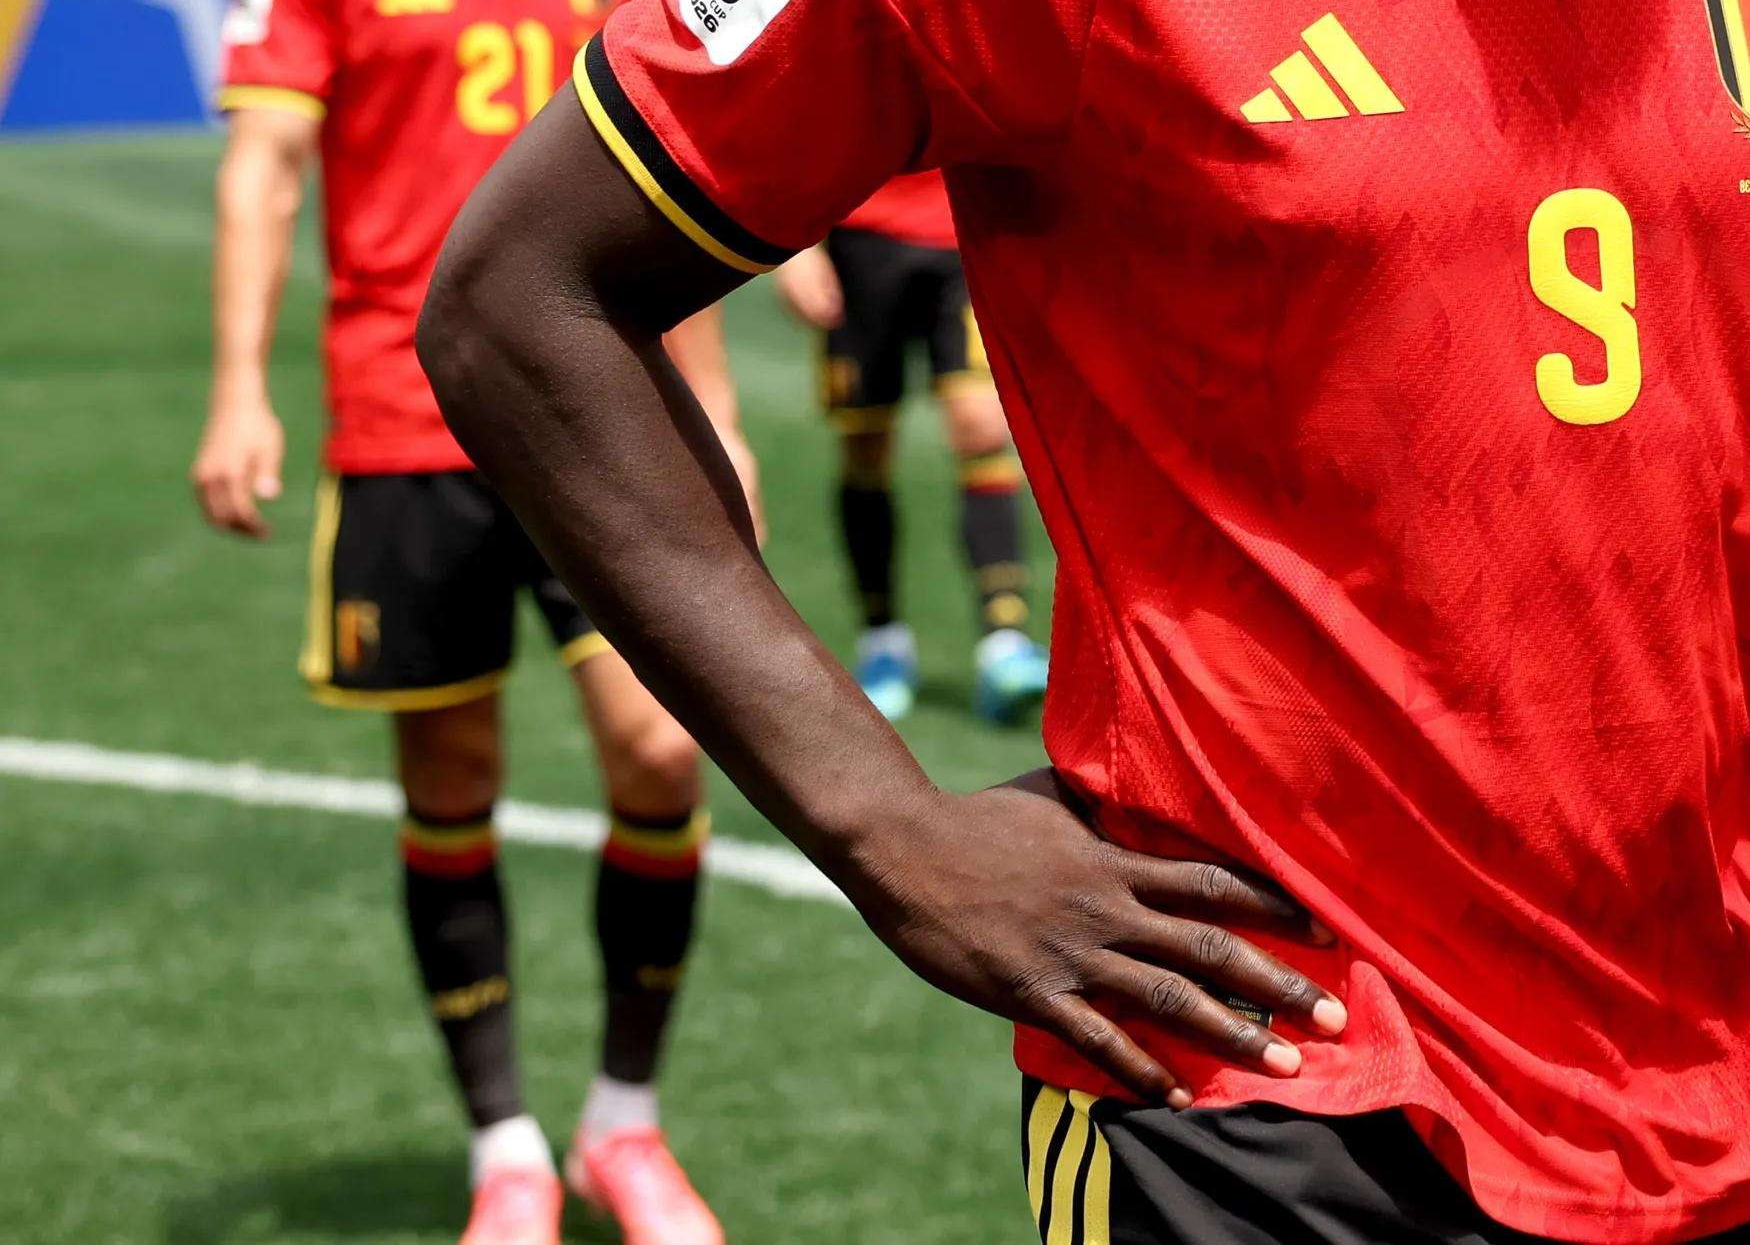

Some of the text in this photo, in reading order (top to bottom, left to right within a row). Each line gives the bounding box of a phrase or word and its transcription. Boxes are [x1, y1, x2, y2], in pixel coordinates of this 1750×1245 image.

[710, 0, 727, 19] CUP
[456, 19, 553, 135] 21
[1527, 187, 1642, 425] 9
